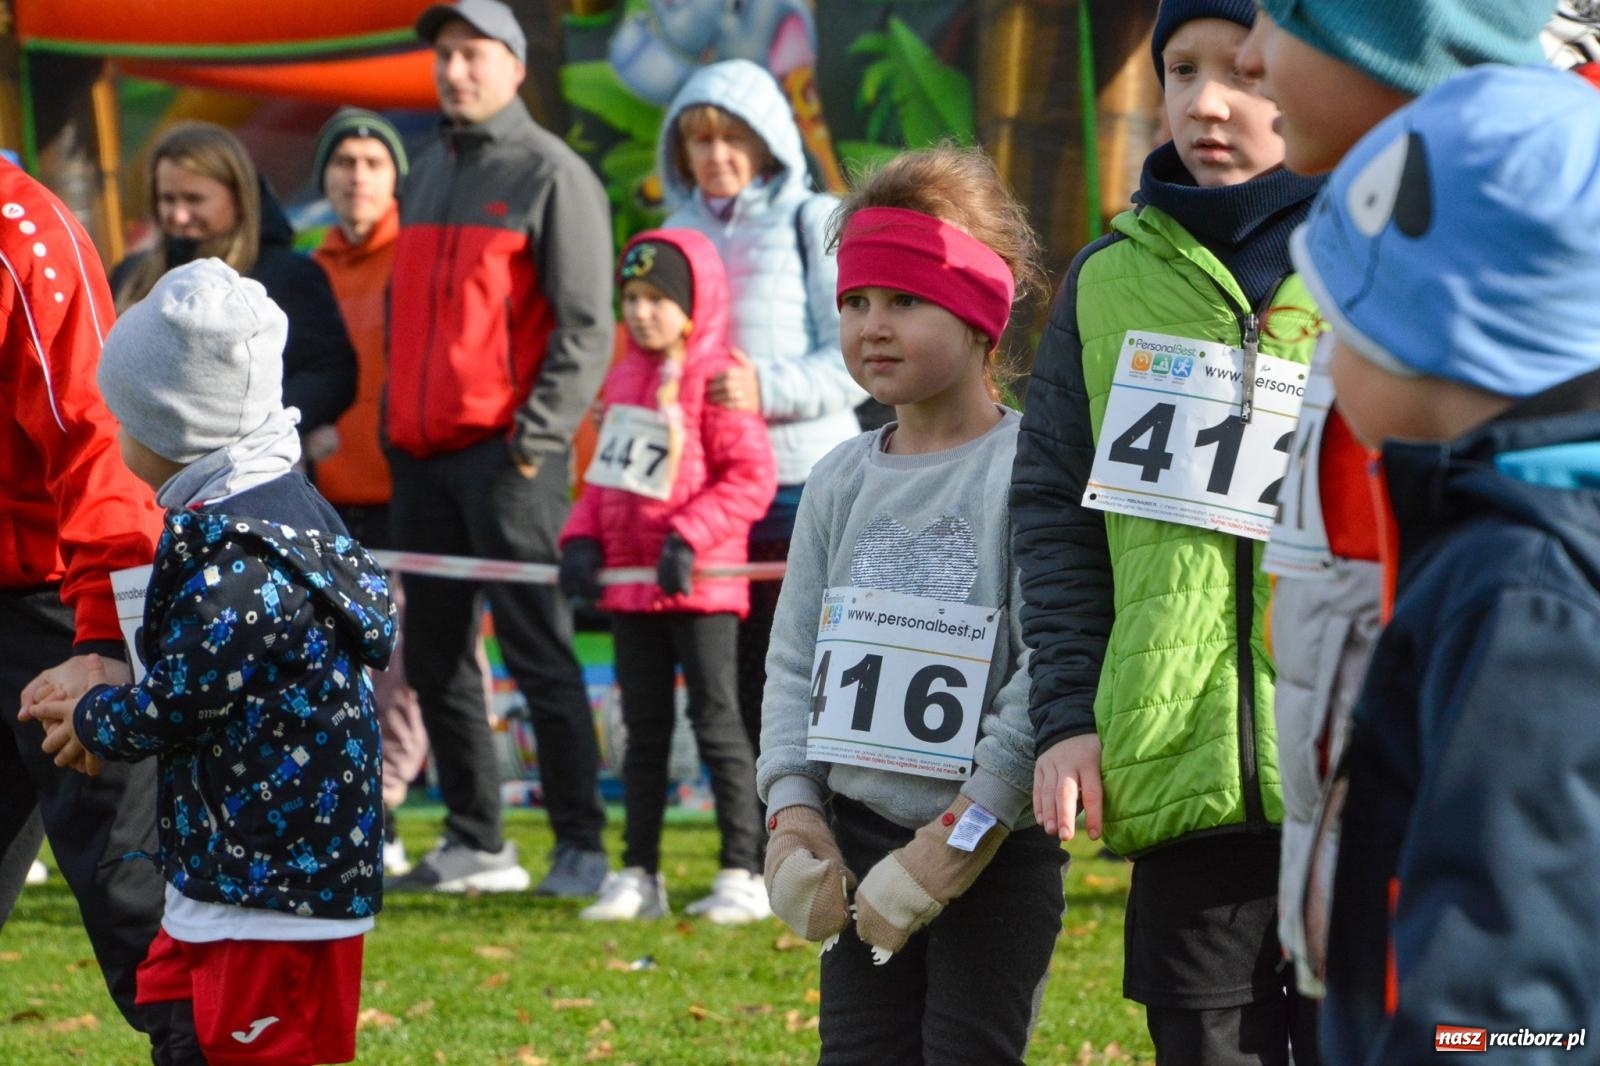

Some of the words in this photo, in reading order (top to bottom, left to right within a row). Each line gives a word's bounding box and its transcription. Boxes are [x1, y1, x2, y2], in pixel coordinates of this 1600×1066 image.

[600, 436, 669, 477] 447
[848, 608, 986, 642] www.personalbest.pl
[810, 650, 968, 744] 416
